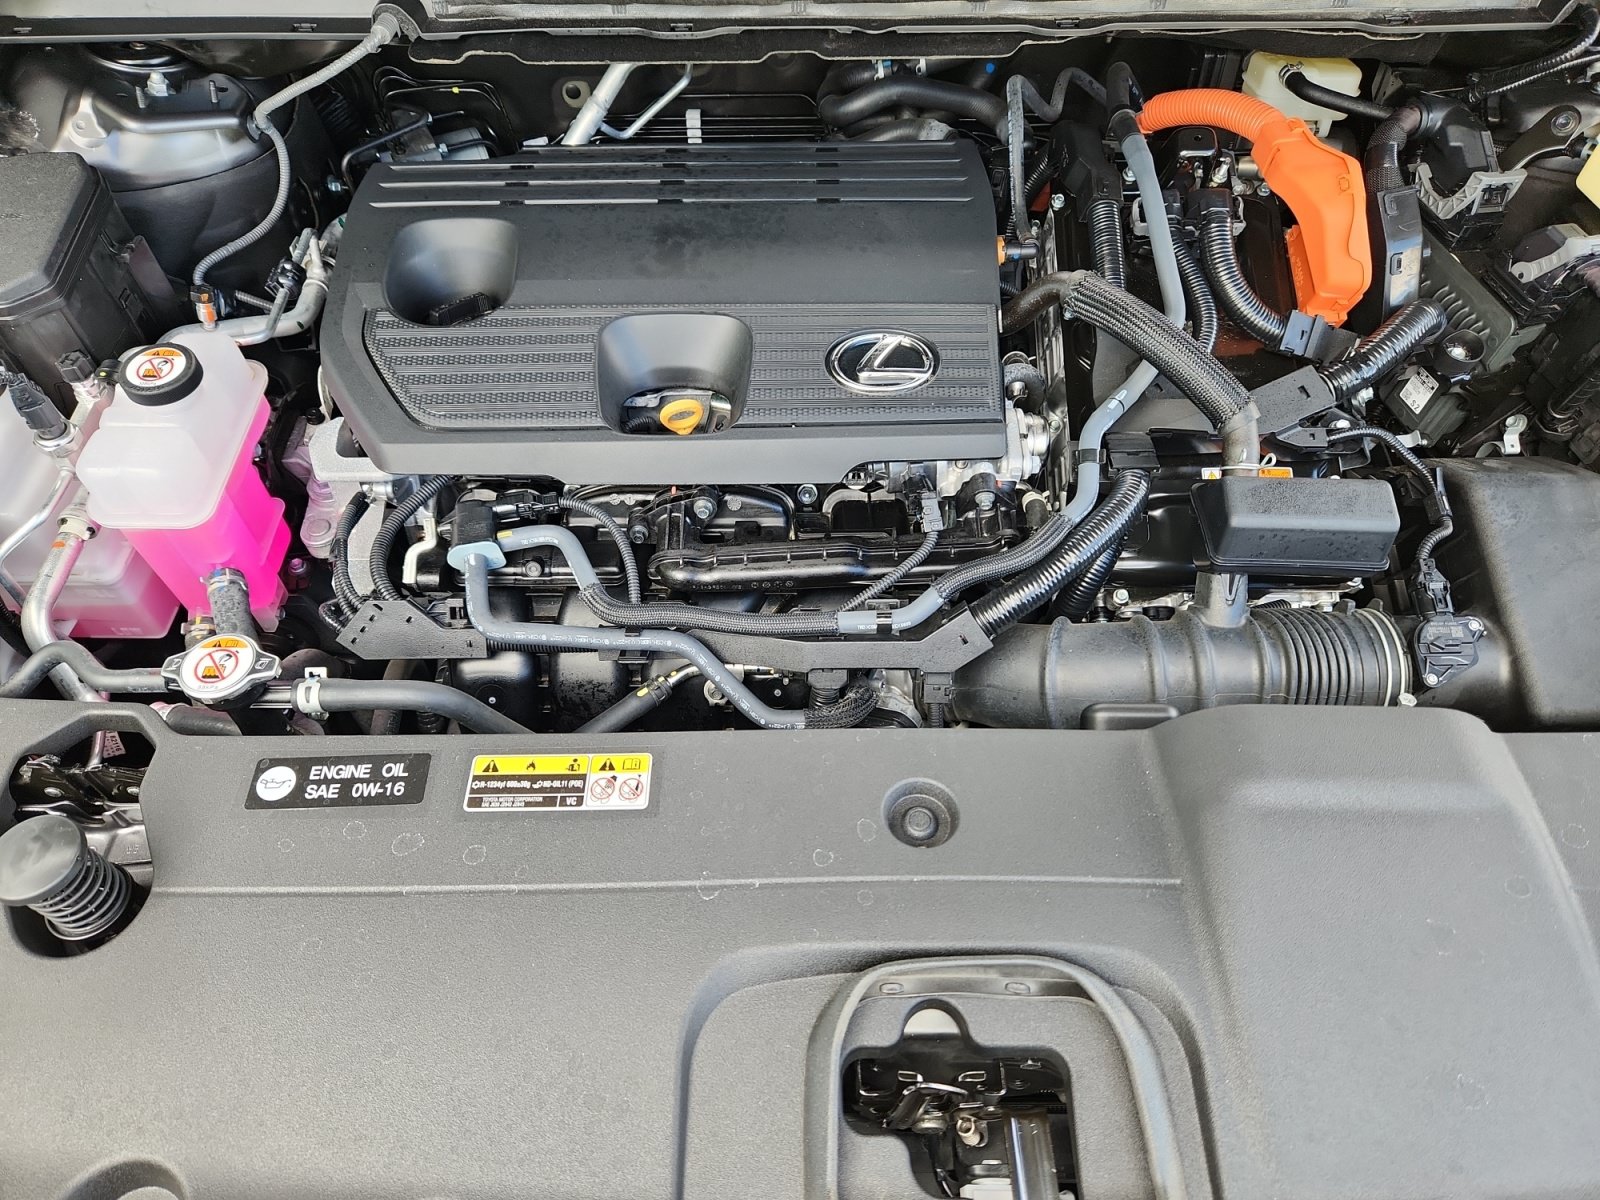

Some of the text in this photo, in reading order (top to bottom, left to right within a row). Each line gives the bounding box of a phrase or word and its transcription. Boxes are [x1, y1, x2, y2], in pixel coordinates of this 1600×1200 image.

[309, 762, 409, 780] ENGINE OIL
[304, 781, 406, 799] SAE 0W-16
[566, 796, 578, 806] VC
